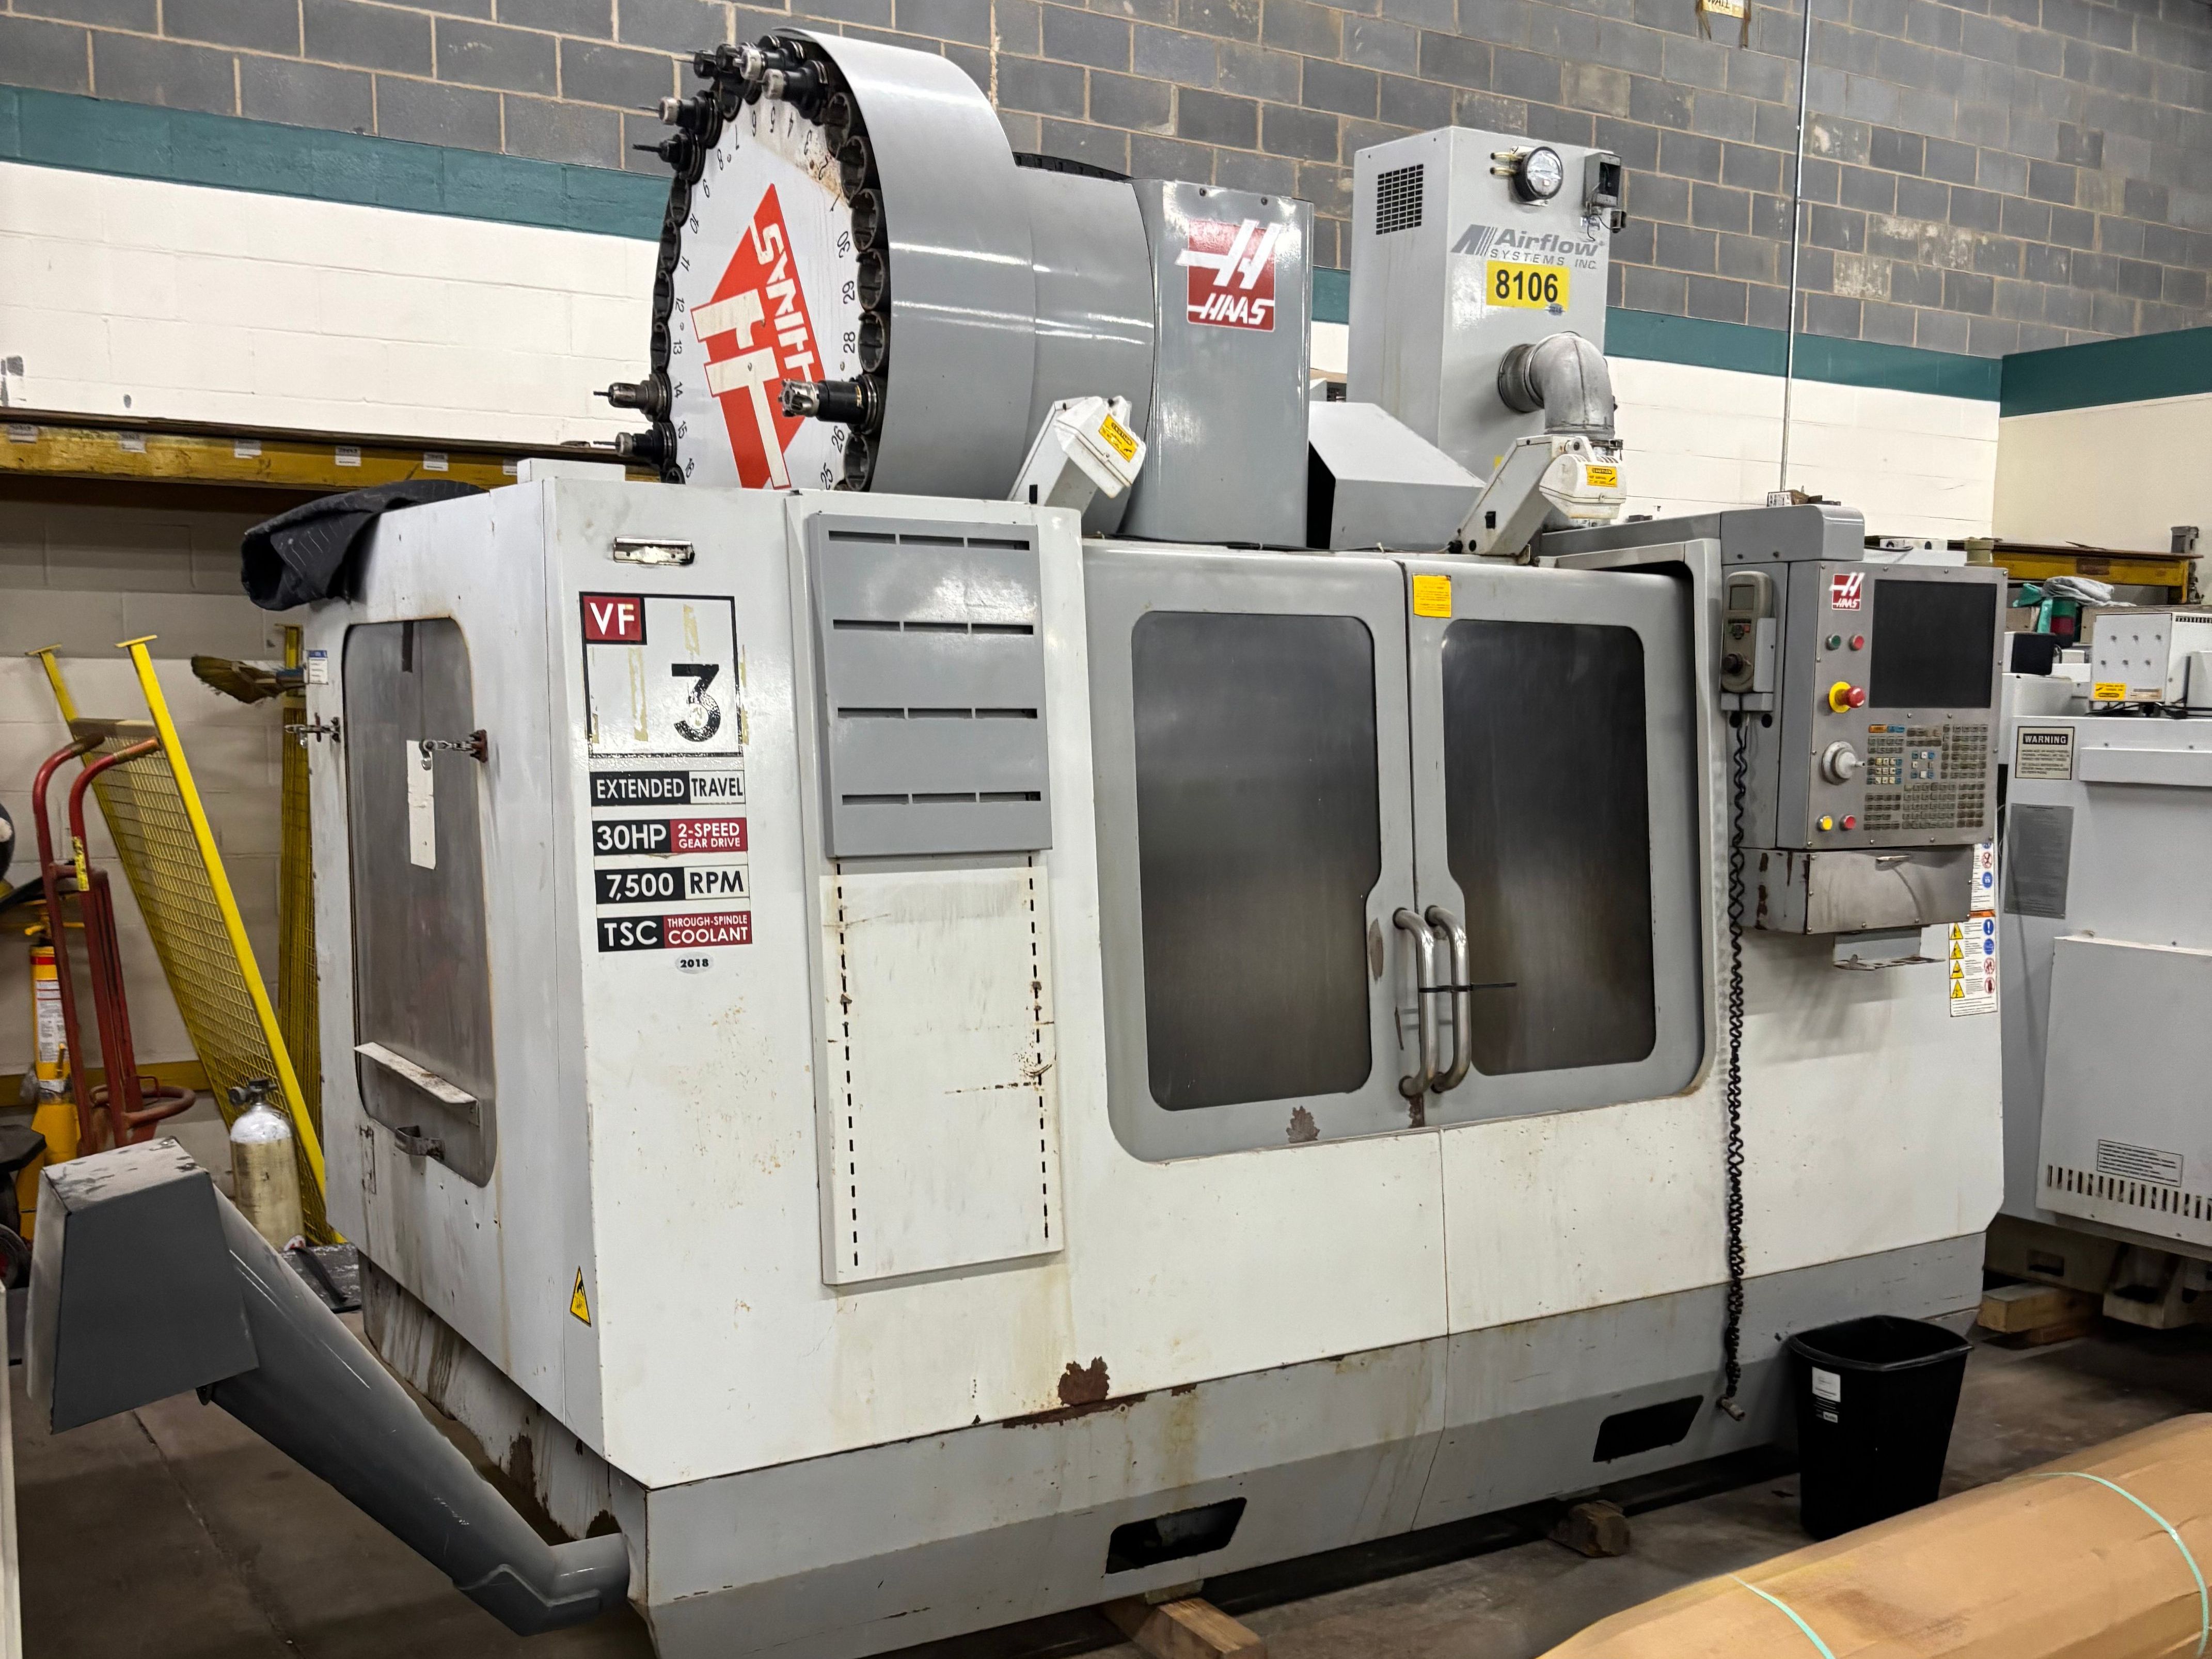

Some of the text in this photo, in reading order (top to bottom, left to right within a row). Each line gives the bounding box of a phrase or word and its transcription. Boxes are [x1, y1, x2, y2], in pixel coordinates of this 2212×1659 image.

[717, 149, 723, 170] 8
[690, 213, 699, 234] 10
[837, 231, 850, 258] 30
[1494, 228, 1599, 256] Airflow
[681, 256, 690, 272] 11
[1490, 249, 1565, 266] SYSTEMS
[842, 280, 855, 305] 29
[1496, 269, 1558, 303] 8106
[675, 297, 685, 313] 12
[1188, 293, 1275, 325] HAAS
[673, 339, 682, 355] 13
[843, 331, 855, 354] 28
[674, 381, 683, 398] 14
[678, 420, 687, 439] 15
[831, 425, 845, 453] 26
[685, 457, 694, 478] 16
[820, 462, 833, 491] 25
[1833, 598, 1860, 608] HAAS
[590, 602, 635, 635] VF
[671, 663, 721, 742] 3
[2024, 735, 2066, 744] WARNING
[596, 777, 743, 799] EXTENDED TRAVEL
[597, 824, 667, 850] 30HP
[678, 823, 739, 838] 2-SPEED
[679, 837, 740, 849] GEAR DRIVE
[606, 871, 744, 901] 7,500 RPM
[667, 914, 747, 927] THROUGH-SPINDLE
[604, 920, 657, 947] TSC
[668, 926, 748, 944] COOLANT
[680, 959, 709, 969] 2018
